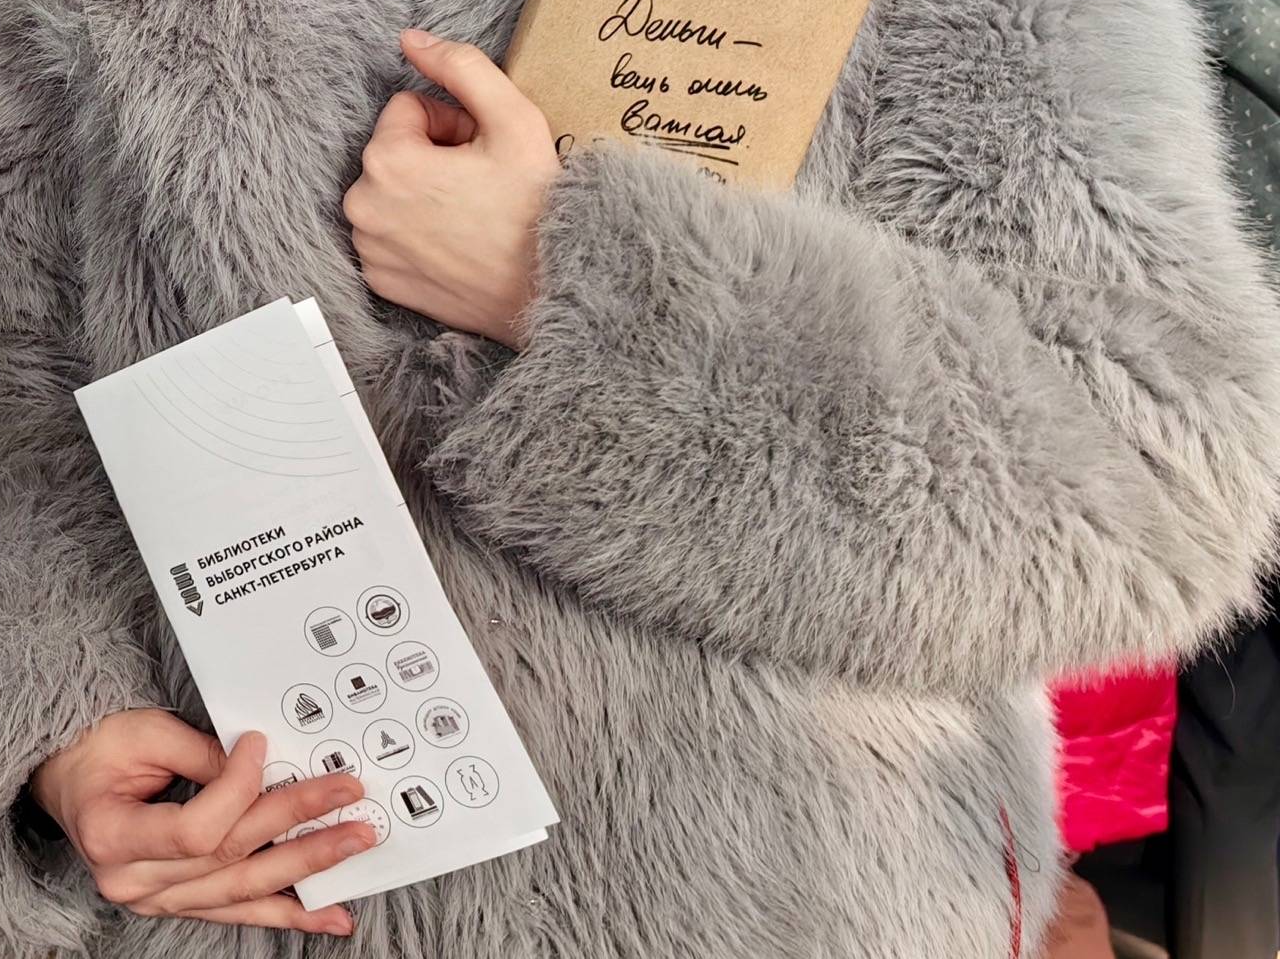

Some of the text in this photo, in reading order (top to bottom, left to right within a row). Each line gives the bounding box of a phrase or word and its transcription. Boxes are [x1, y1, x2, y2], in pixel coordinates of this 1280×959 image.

[197, 526, 286, 570] БИБЛИОТЕКИ
[206, 516, 364, 588] ВЫБОРГСКОГО РАЙОНА
[214, 546, 345, 606] САНКТ-ПЕТЕРБУРГА
